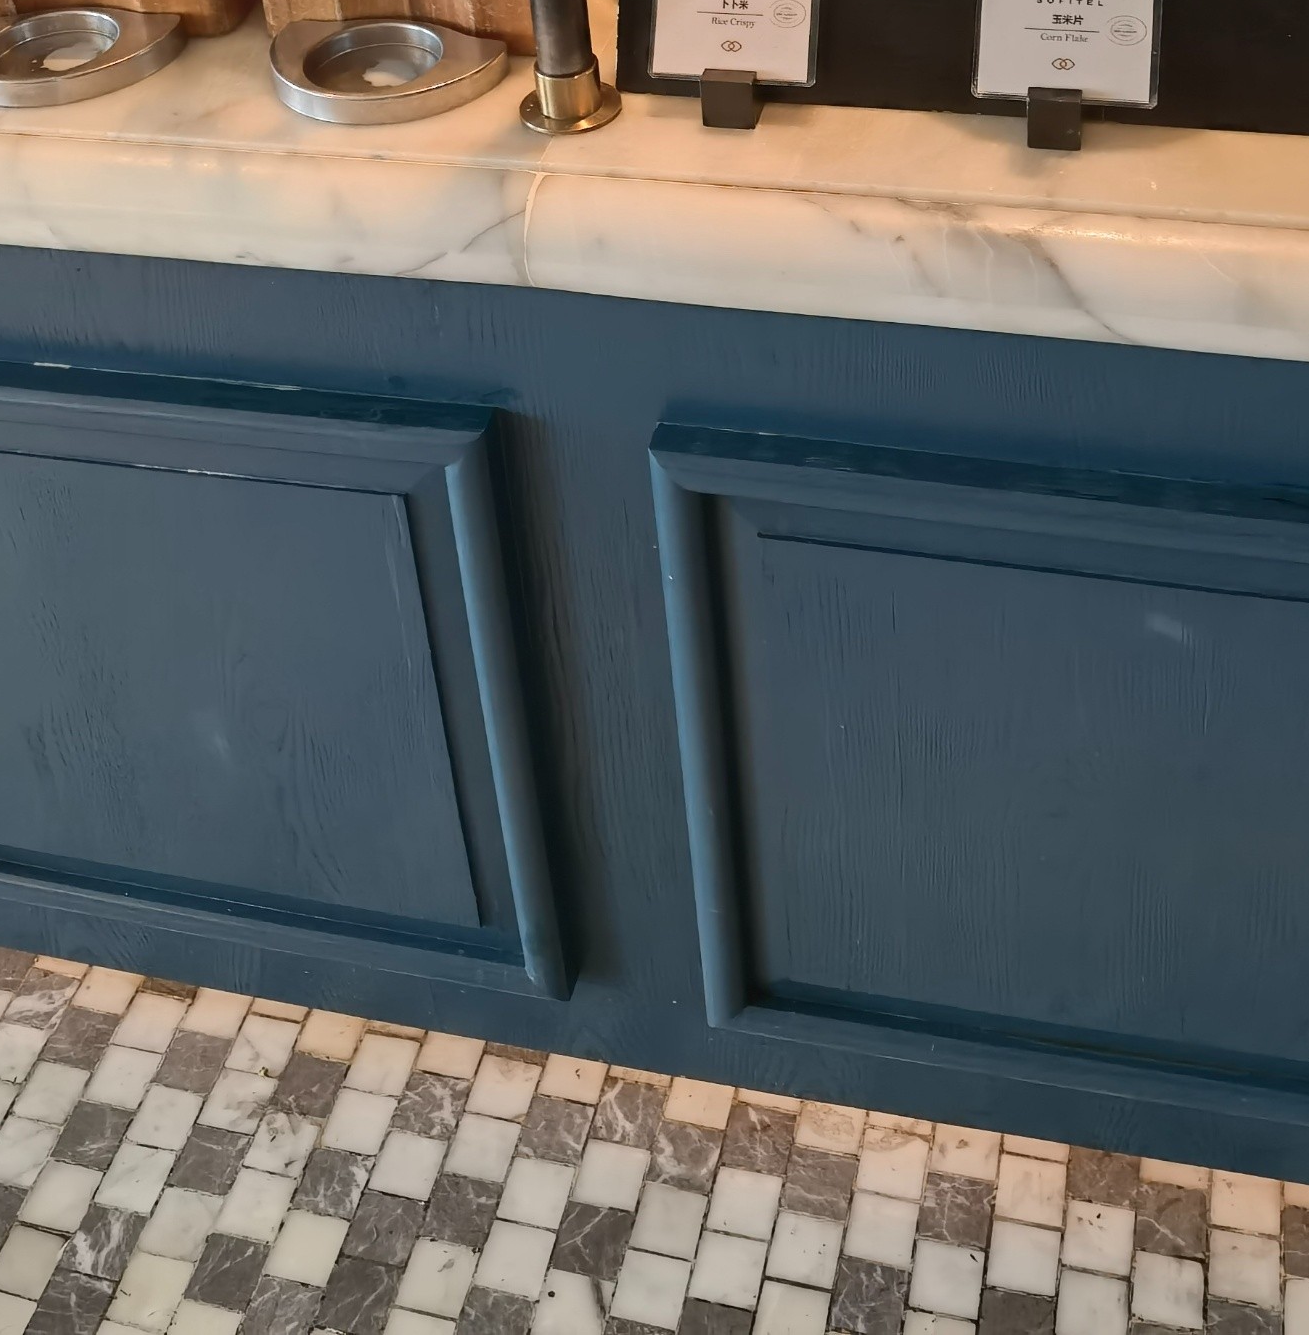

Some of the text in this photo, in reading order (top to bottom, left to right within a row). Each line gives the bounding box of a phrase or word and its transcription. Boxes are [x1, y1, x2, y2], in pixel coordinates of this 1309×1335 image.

[711, 17, 756, 29] Rice Crispy
[1052, 14, 1084, 26] 玉米片
[1040, 32, 1089, 43] Corn Flake
